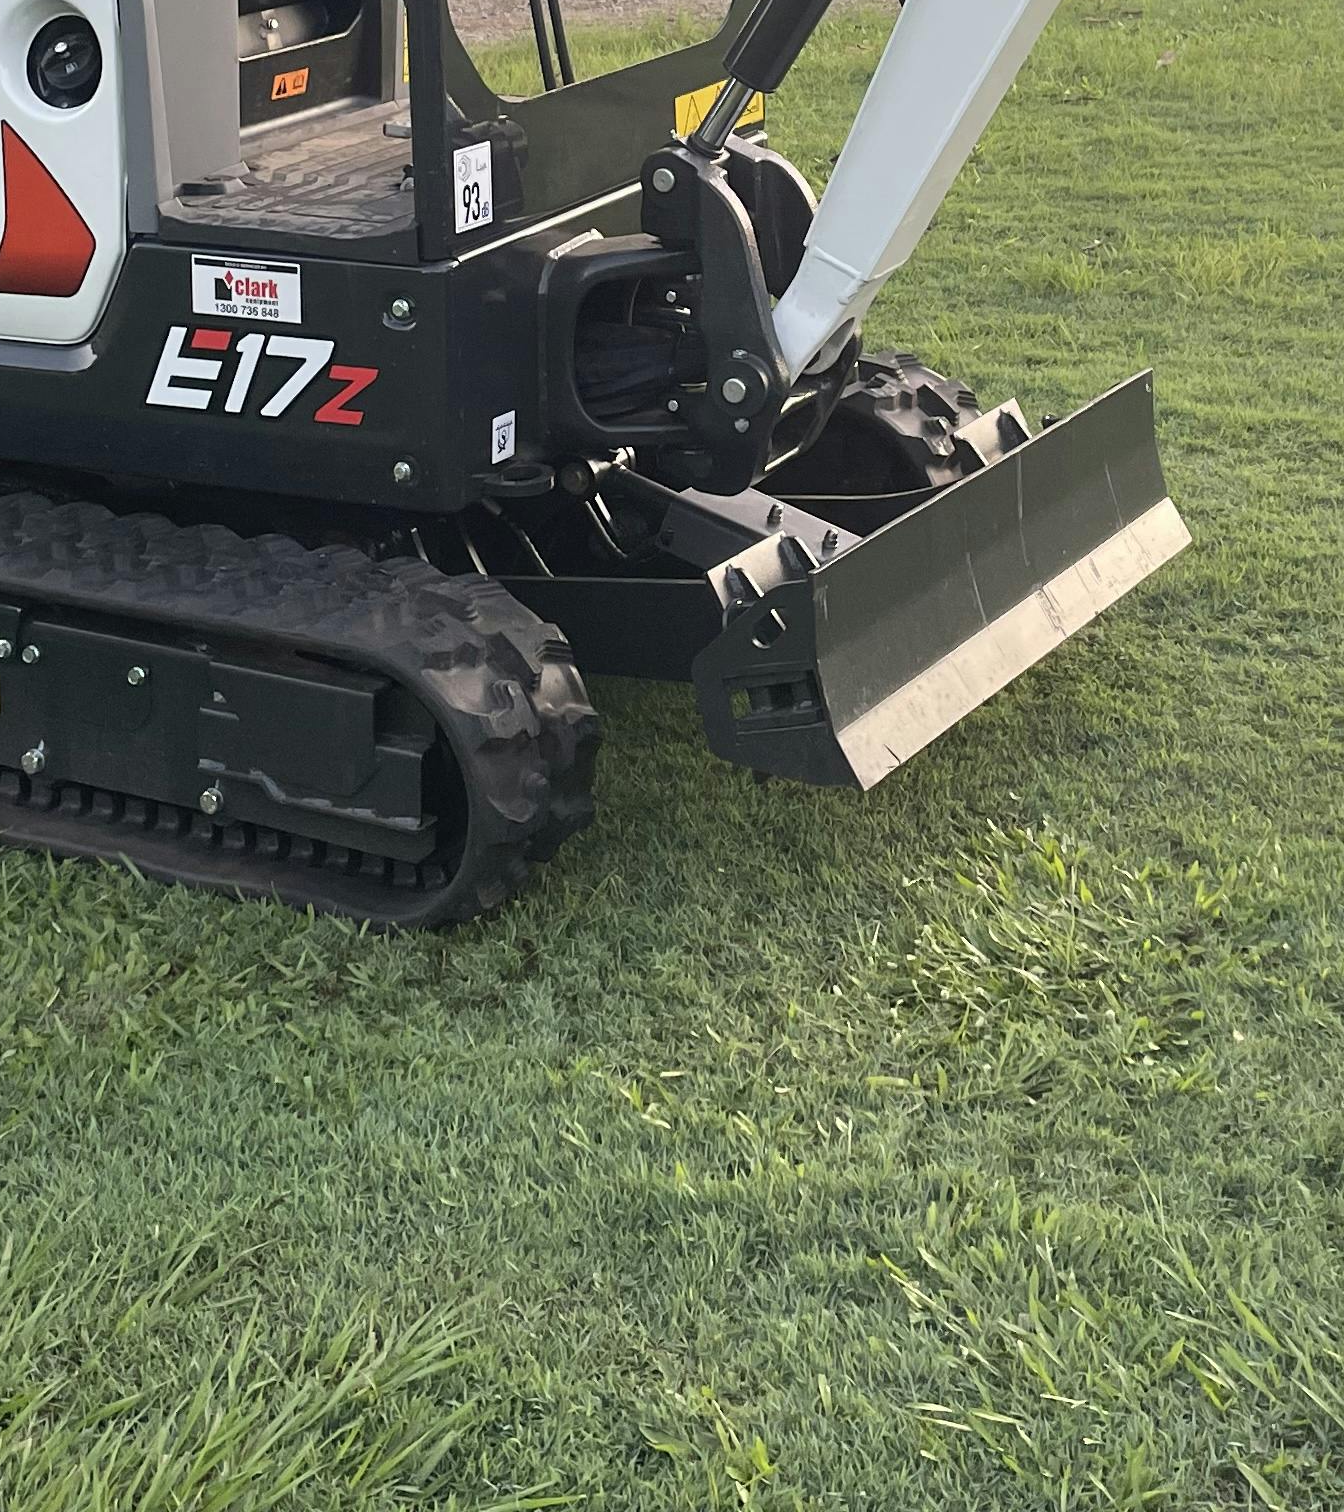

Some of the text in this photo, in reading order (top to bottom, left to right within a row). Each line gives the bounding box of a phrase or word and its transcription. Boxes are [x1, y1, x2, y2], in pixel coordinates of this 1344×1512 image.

[462, 181, 480, 224] 93
[235, 277, 279, 299] clark
[215, 303, 280, 318] 1300 736 848
